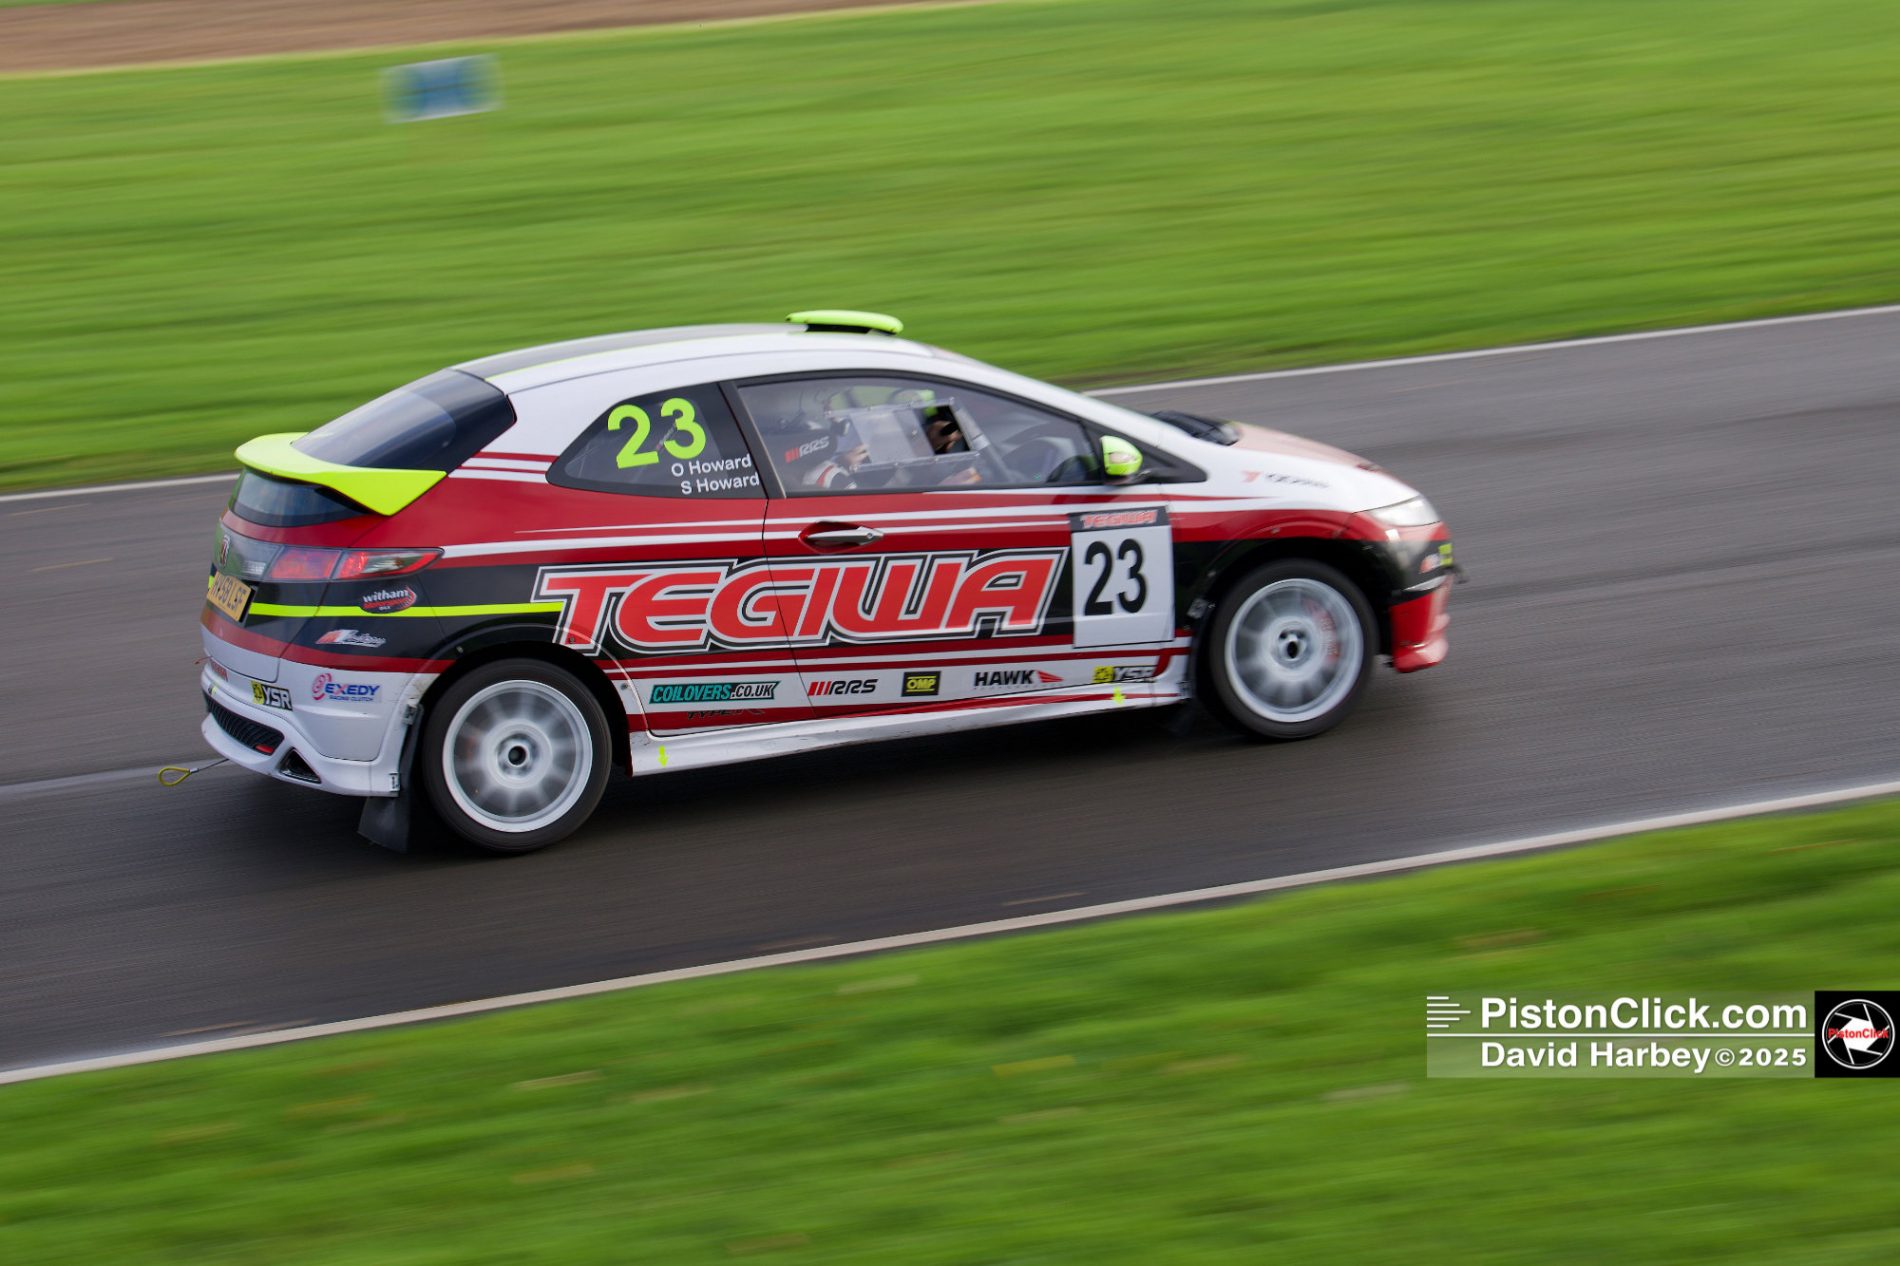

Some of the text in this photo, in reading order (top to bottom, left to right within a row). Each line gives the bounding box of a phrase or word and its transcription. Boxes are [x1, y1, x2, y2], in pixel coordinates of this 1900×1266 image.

[607, 397, 707, 470] 23
[671, 453, 752, 477] O Howard
[680, 471, 760, 495] S Howard
[1084, 538, 1148, 616] 23
[531, 547, 1070, 656] TEGIWA
[325, 683, 380, 696] EXEDY
[827, 679, 879, 695] RRS
[906, 678, 937, 690] OMP
[974, 670, 1035, 686] HAWK
[262, 685, 292, 709] YSR
[652, 683, 773, 702] COILOVERS.CO.UK
